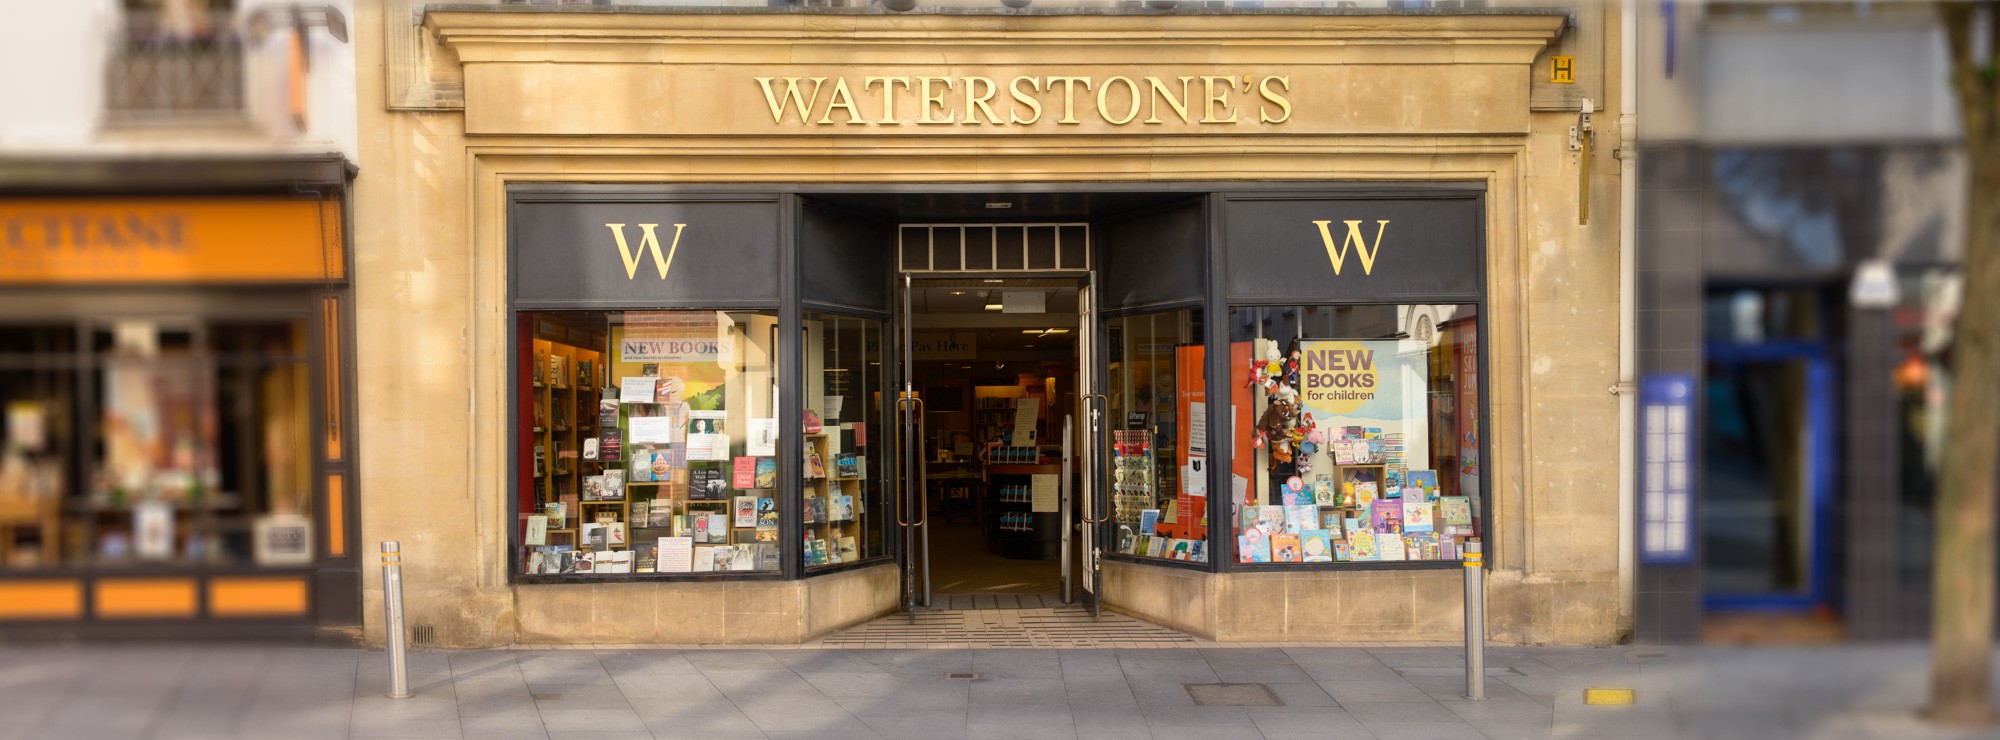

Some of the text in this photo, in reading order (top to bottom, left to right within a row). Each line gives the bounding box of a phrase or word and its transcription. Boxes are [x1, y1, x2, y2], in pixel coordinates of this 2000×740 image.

[1553, 58, 1572, 80] H
[754, 75, 1292, 125] WATERSTONE'S
[605, 223, 687, 280] W
[1312, 219, 1390, 276] W
[624, 341, 730, 355] NEW BOOKS
[1306, 349, 1375, 371] NEW
[1306, 373, 1375, 389] BOOKS
[1307, 389, 1375, 400] for children
